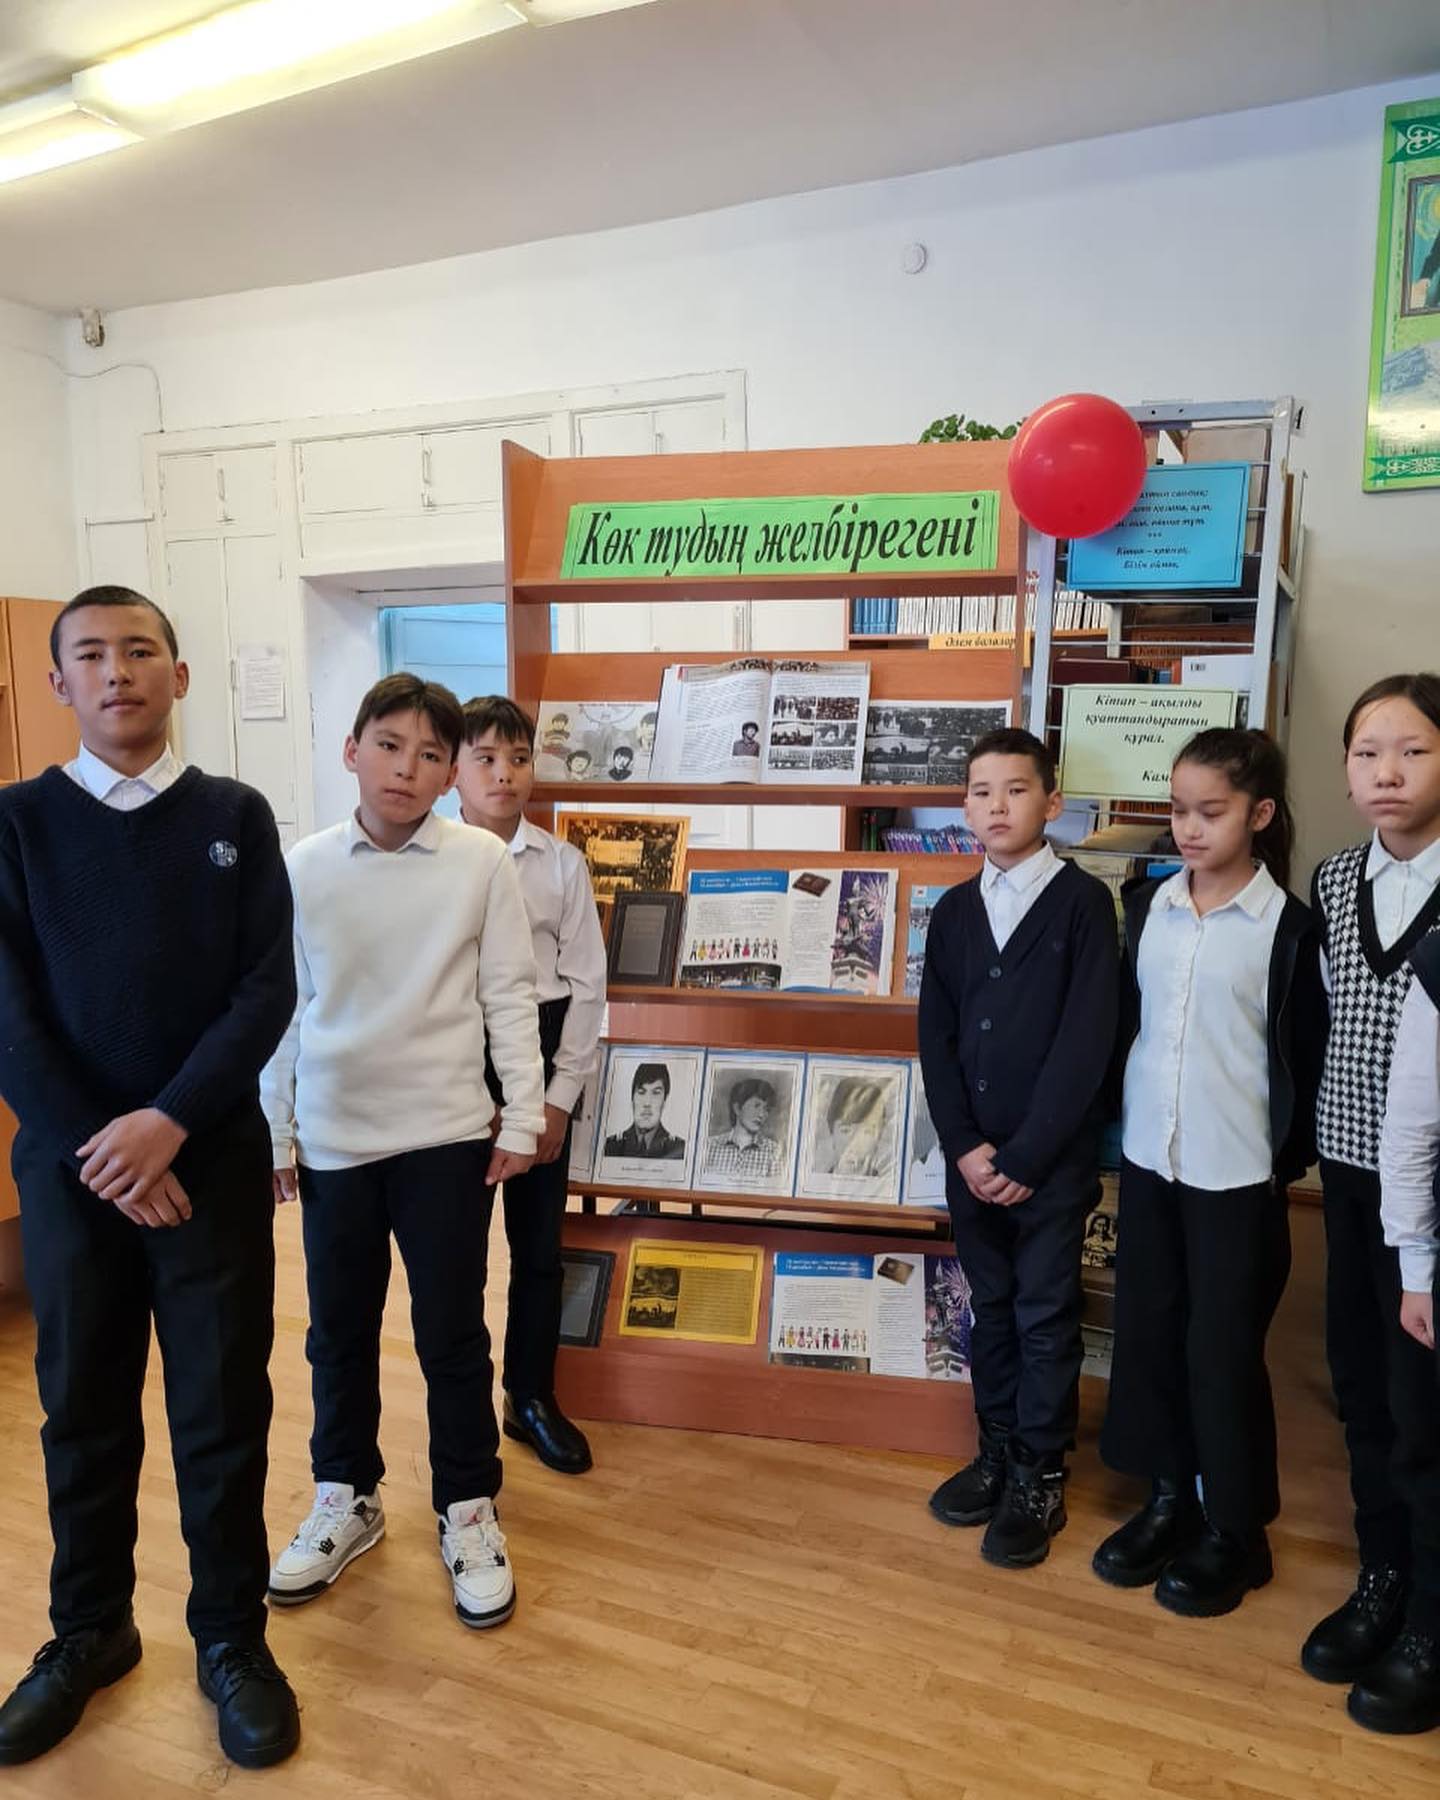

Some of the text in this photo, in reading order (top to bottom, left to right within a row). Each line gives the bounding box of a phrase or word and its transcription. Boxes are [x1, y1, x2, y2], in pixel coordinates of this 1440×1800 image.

[577, 498, 980, 577] Көк тудың желбірегені
[1095, 694, 1136, 707] Кітап
[1150, 695, 1202, 708] ақылды
